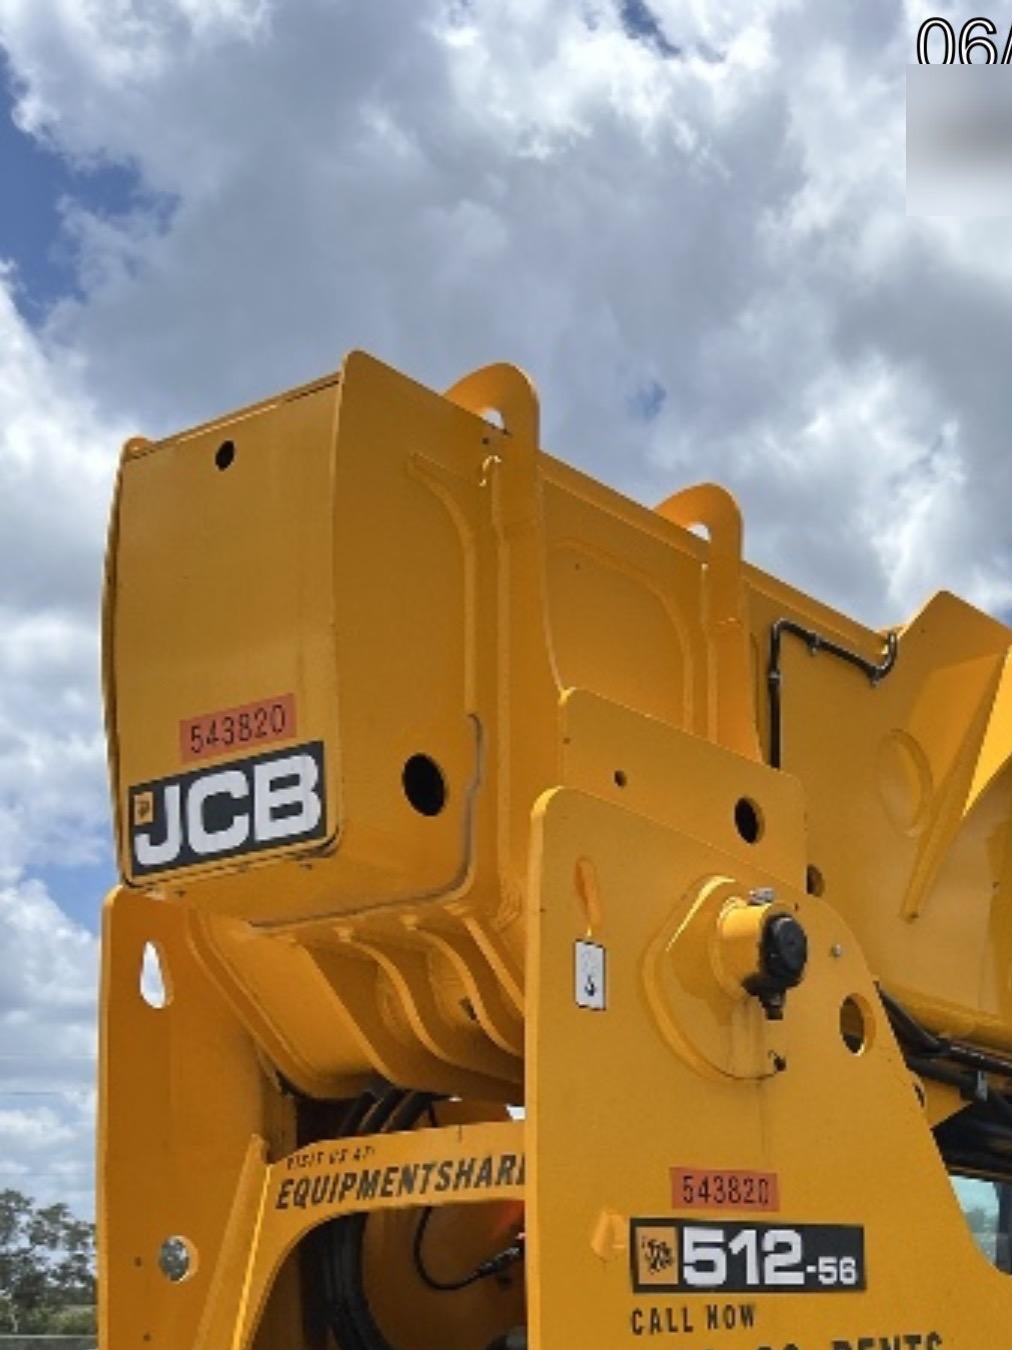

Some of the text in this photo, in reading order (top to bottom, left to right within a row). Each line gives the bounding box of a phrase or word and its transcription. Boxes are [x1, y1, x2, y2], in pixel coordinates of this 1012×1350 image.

[189, 703, 287, 754] 543820
[133, 753, 322, 866] JCB
[682, 1174, 770, 1205] 543820
[630, 1303, 757, 1336] CALL NOW
